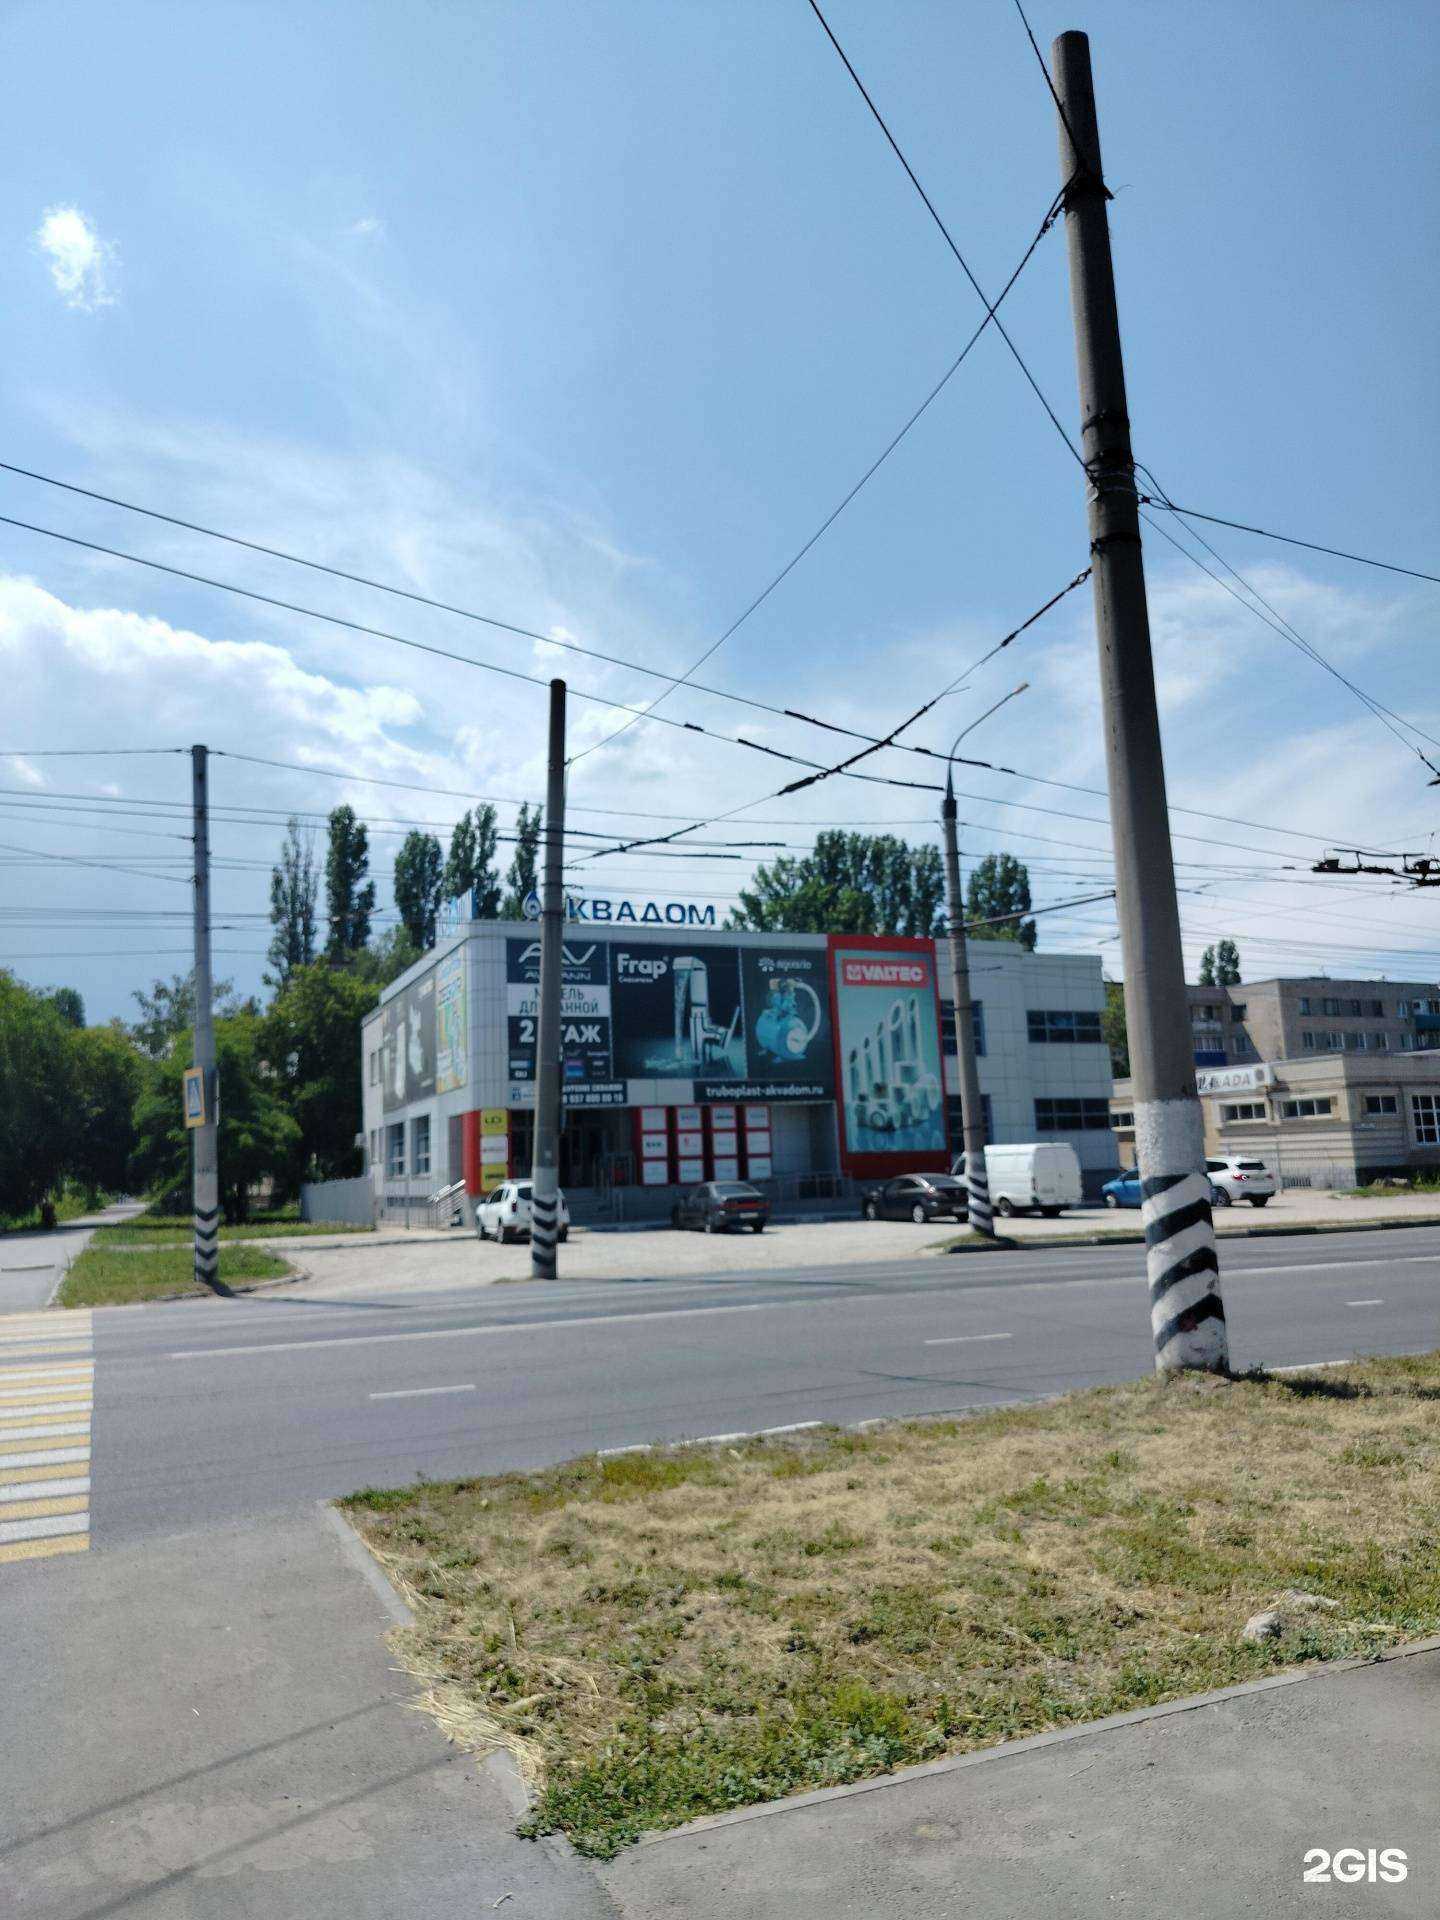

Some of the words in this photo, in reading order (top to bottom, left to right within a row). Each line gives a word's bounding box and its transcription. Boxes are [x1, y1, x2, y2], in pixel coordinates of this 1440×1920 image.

[564, 898, 716, 925] КВАДОМ
[617, 953, 667, 979] Frap
[862, 964, 923, 982] VALTEC
[519, 1019, 535, 1043] 2
[705, 1084, 824, 1098] truboplast-akvadom.ru
